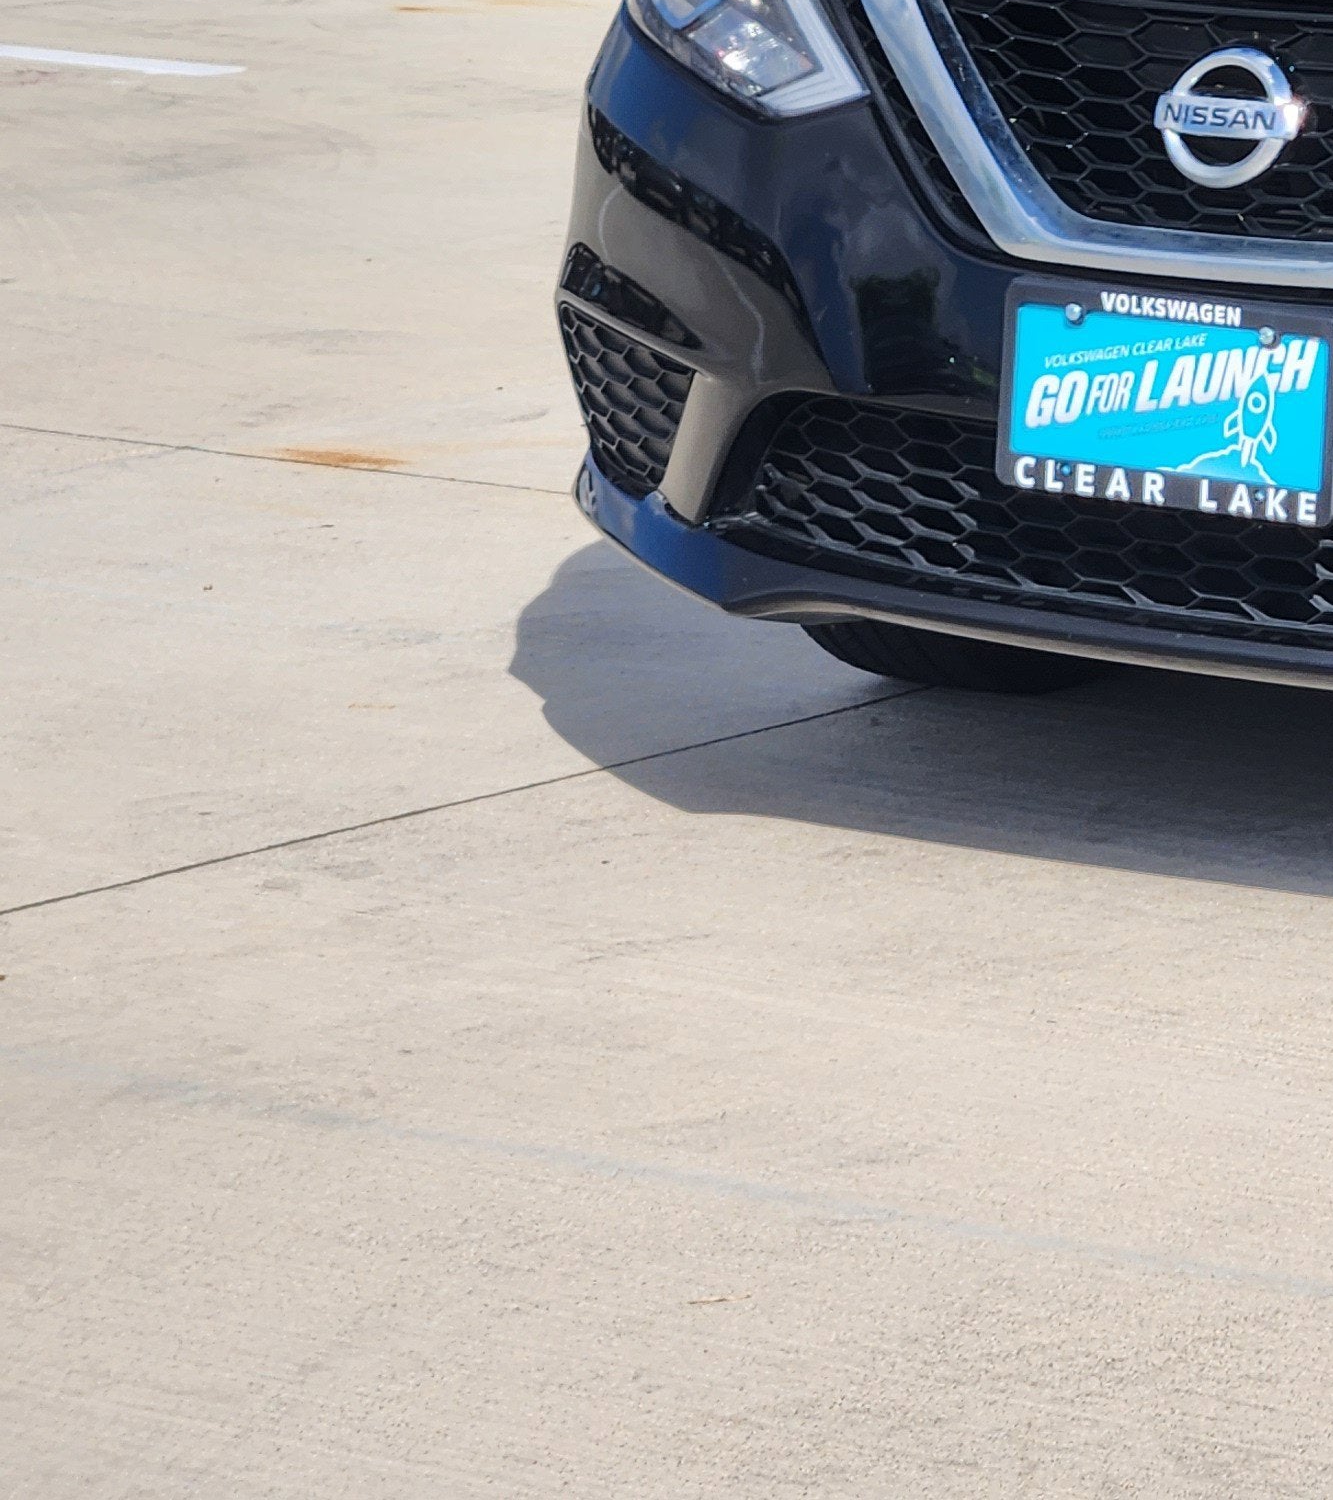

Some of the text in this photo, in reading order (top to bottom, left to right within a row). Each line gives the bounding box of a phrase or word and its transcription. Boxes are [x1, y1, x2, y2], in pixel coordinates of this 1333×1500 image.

[1163, 103, 1277, 130] NISSAN
[1101, 291, 1242, 327] VOLKSWAGEN
[1044, 332, 1208, 369] VOLKSWAGEN CLEAR LAKE
[1025, 369, 1089, 428] GO
[1086, 371, 1135, 416] FOR
[1135, 338, 1319, 413] LAUNCH
[1013, 456, 1318, 525] CLEAR LAKE
